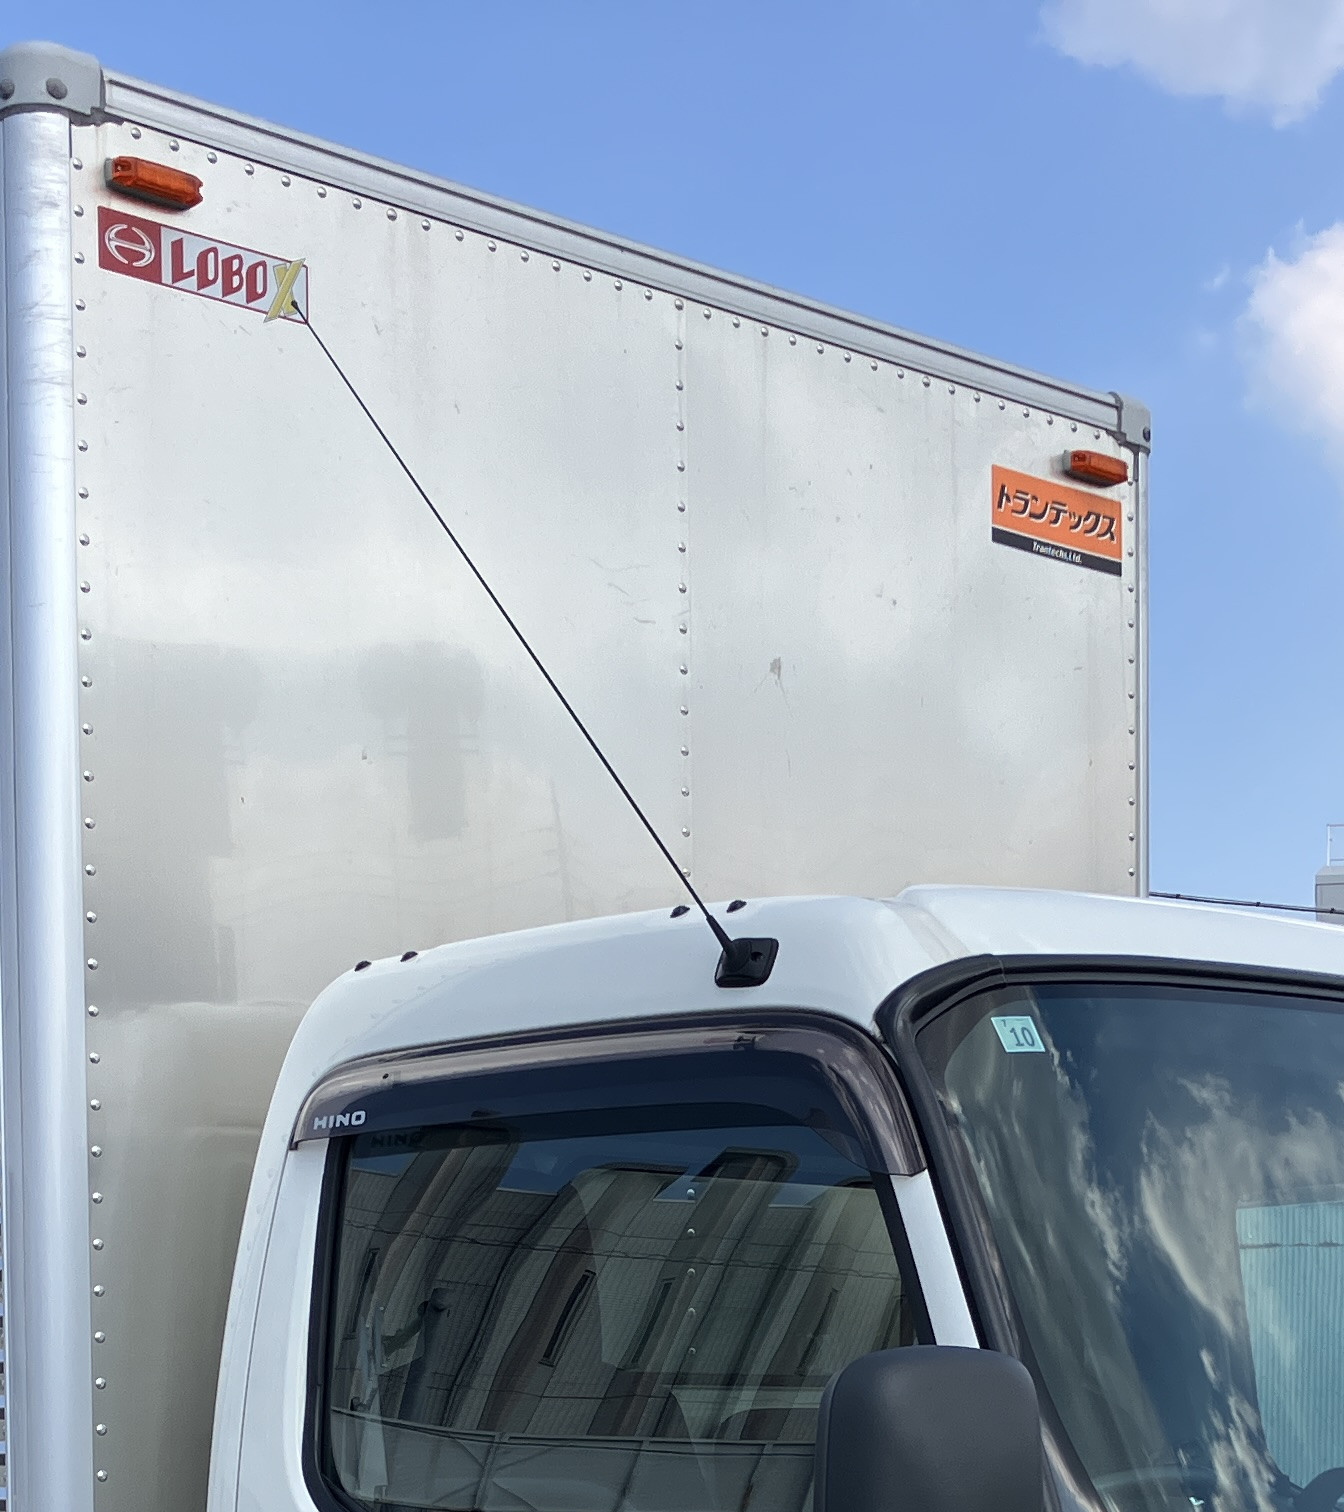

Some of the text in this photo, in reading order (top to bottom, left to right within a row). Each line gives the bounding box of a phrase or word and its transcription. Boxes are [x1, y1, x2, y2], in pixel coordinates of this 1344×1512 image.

[996, 482, 1117, 544] トランテックス
[1009, 1026, 1035, 1047] 10
[313, 1110, 366, 1130] HINO
